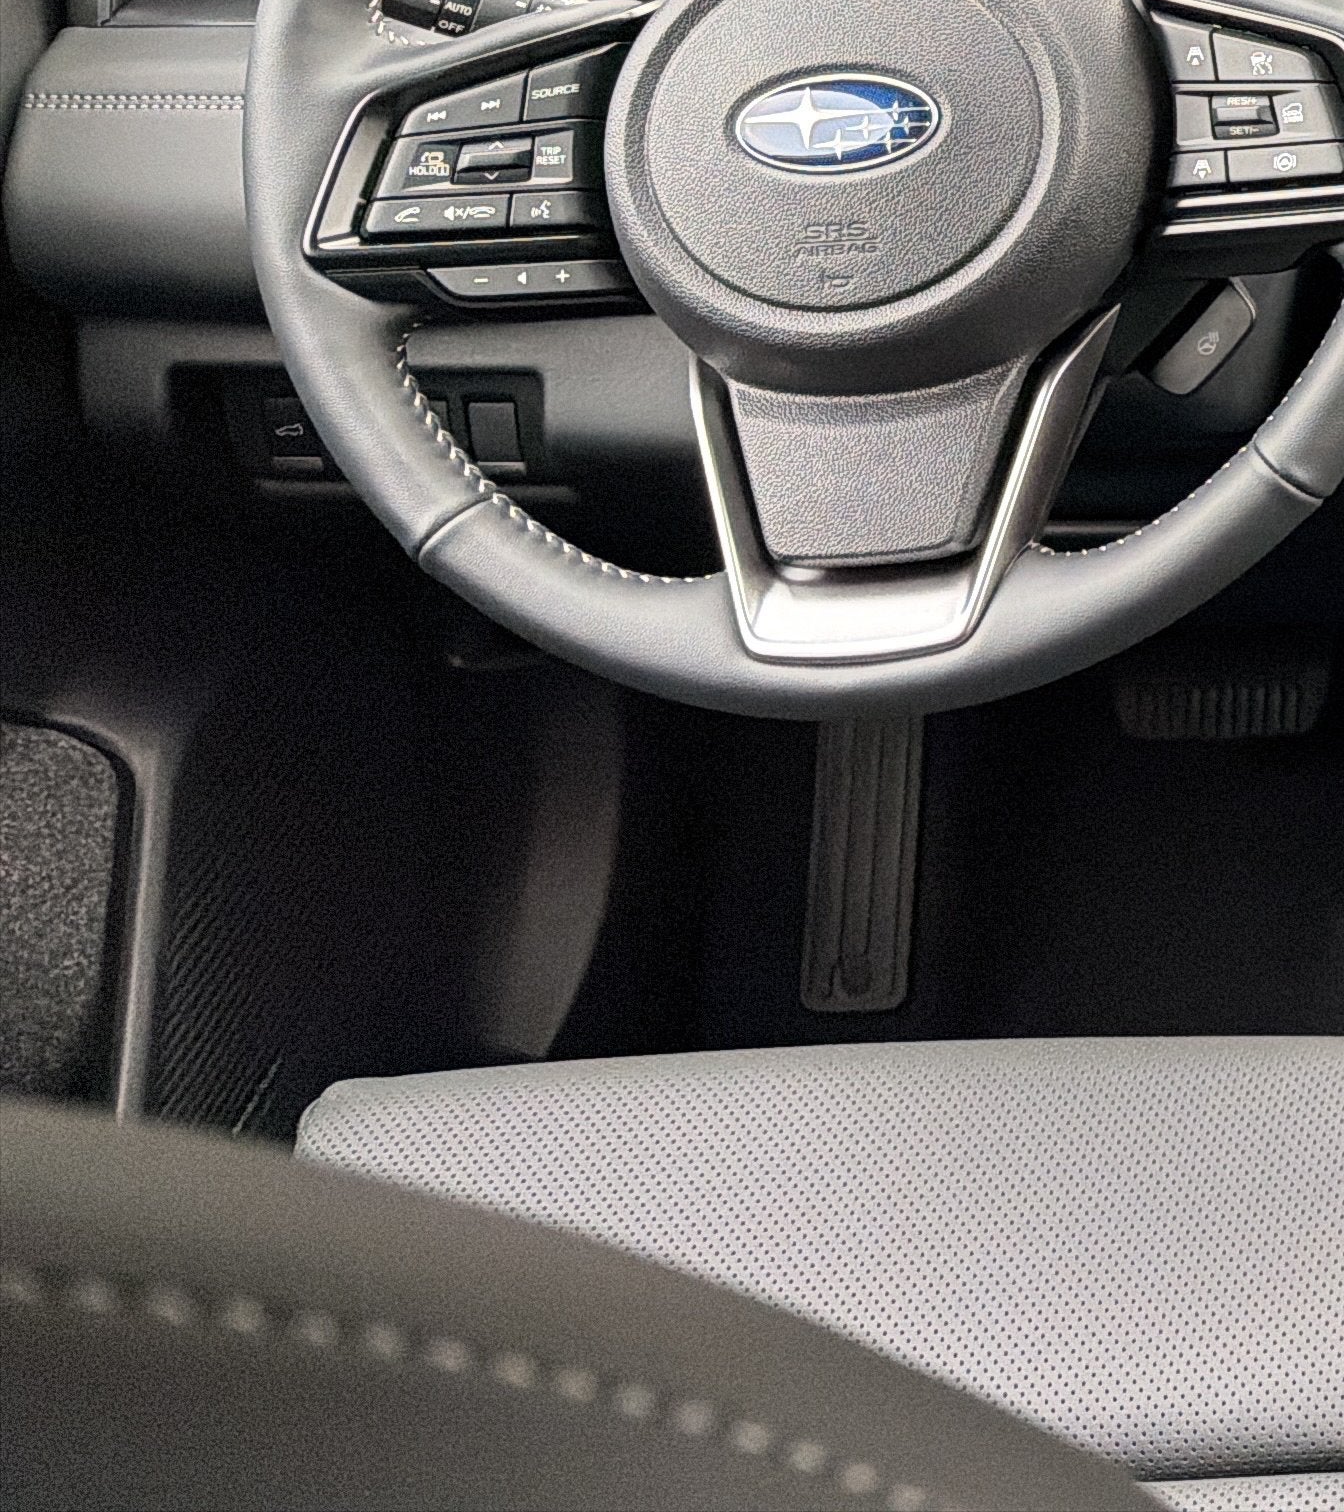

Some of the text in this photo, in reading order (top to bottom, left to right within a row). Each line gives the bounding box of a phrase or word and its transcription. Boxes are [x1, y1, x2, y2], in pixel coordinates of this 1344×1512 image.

[443, 2, 473, 16] AUTO
[438, 19, 465, 33] OFF
[531, 83, 580, 100] SOURCE
[540, 146, 561, 155] TRIP
[535, 155, 567, 165] RESET
[409, 166, 437, 176] HOLD
